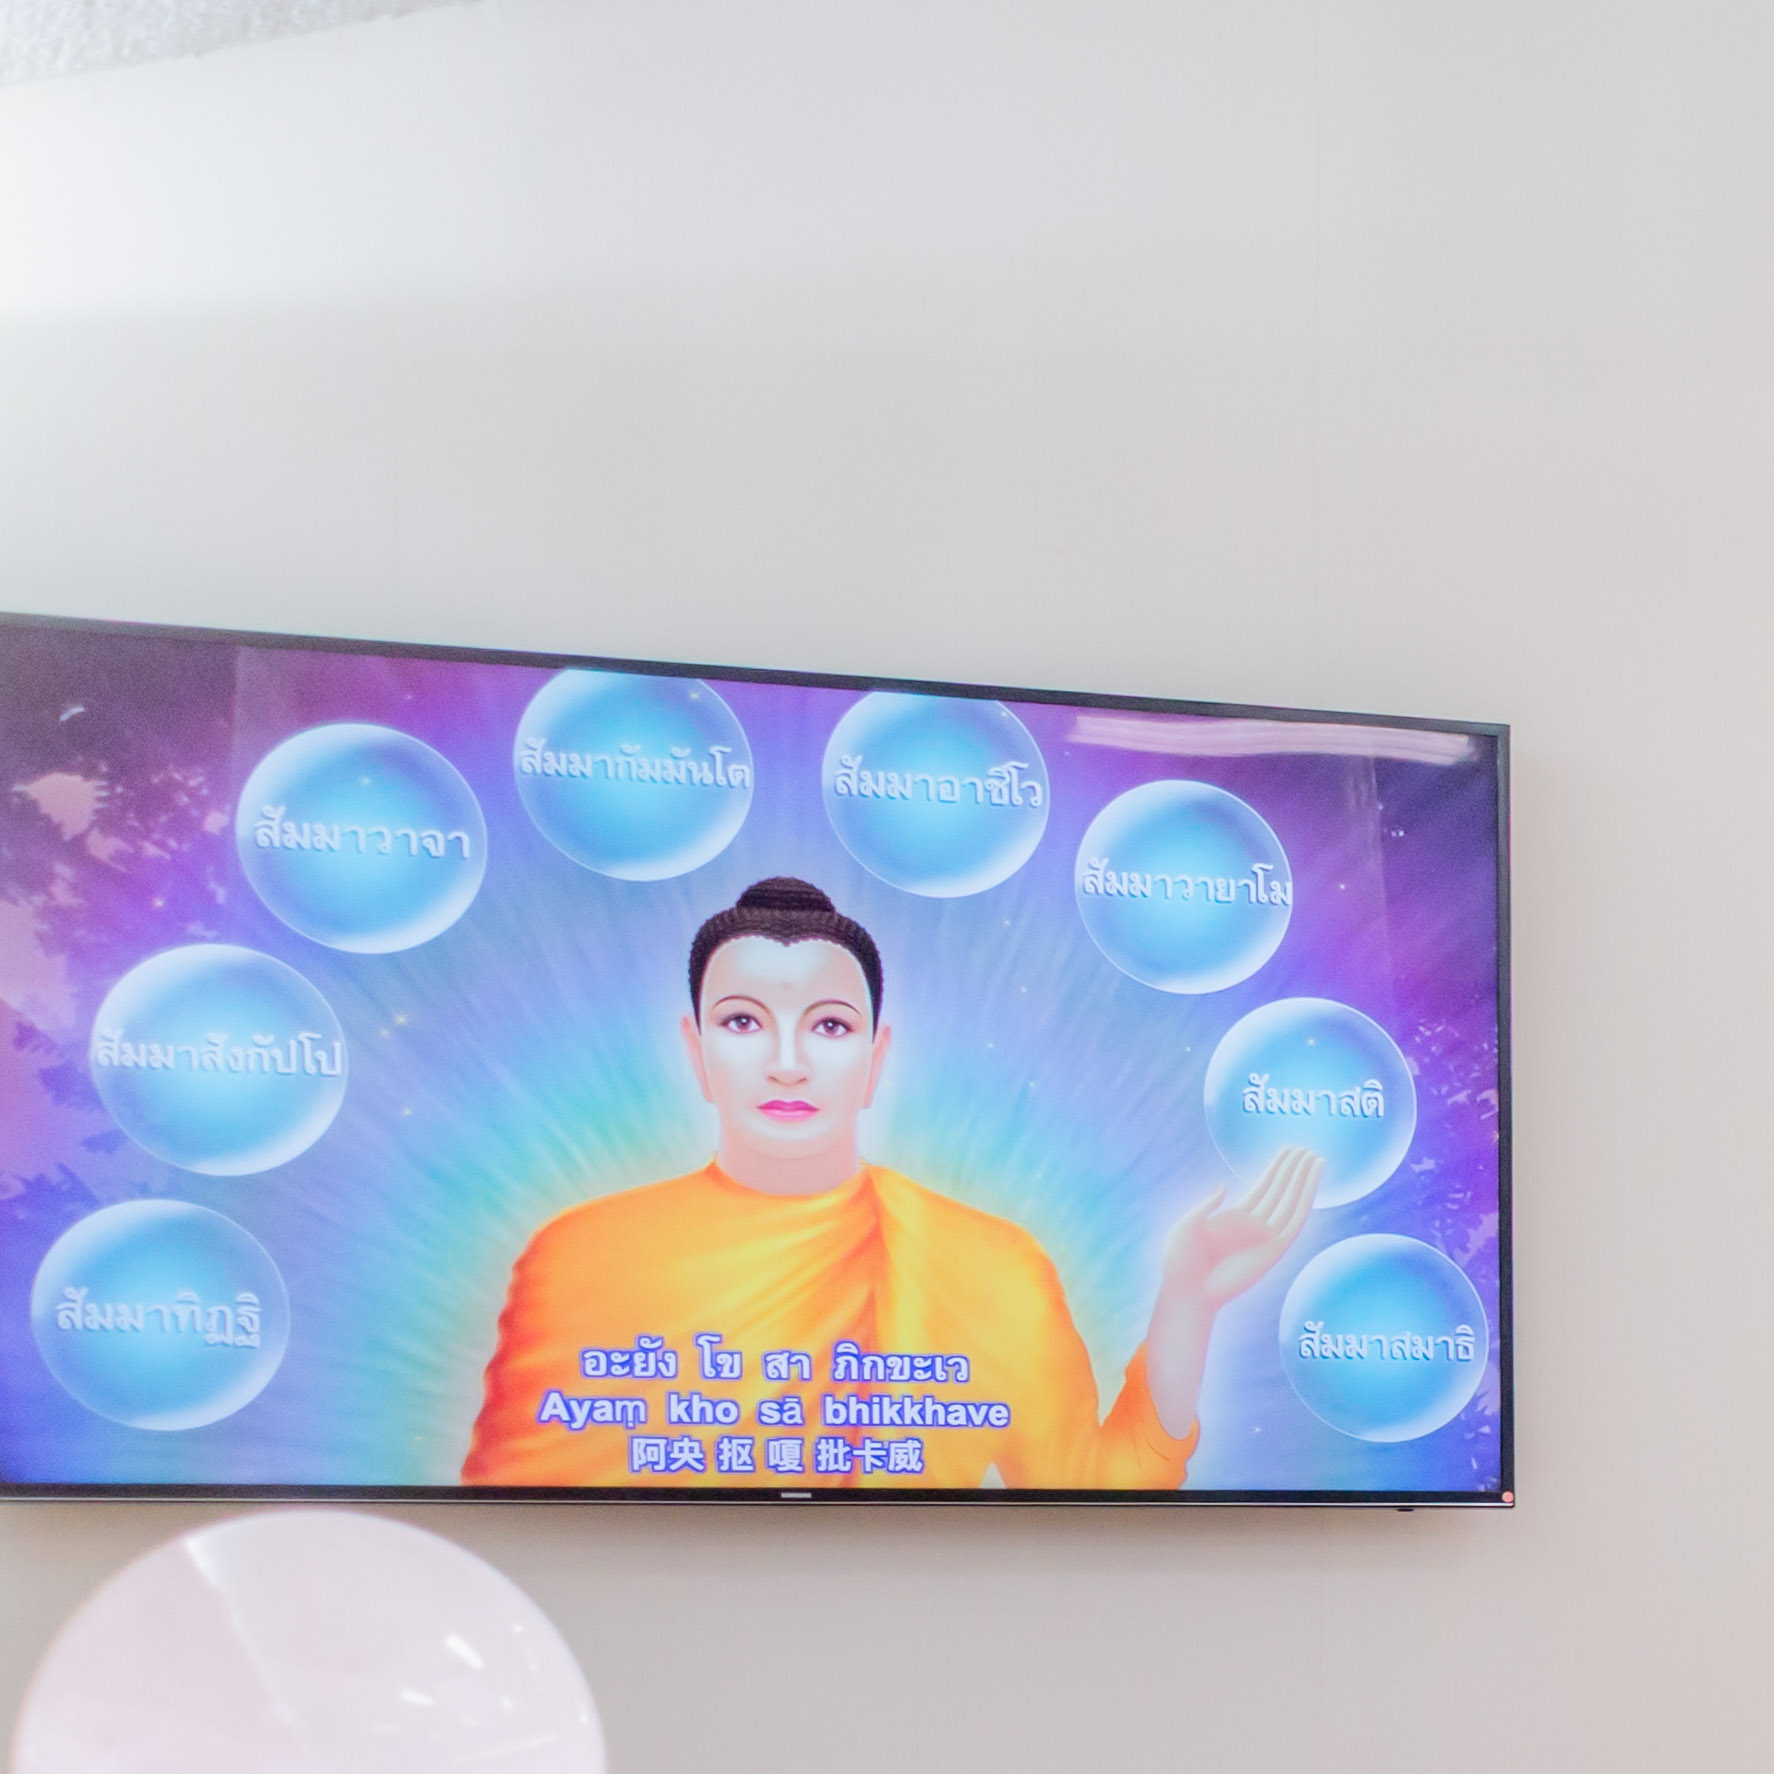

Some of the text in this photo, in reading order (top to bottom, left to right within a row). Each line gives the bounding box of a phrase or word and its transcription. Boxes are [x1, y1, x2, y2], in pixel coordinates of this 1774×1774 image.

[519, 738, 751, 787] สัมมากัมมันโต
[255, 805, 471, 859] สัมมาวาจา
[1082, 857, 1292, 906] สัมมาวายาโม
[97, 1029, 342, 1076] สัมมาสังกัปโป
[1242, 1073, 1385, 1118] สัมมาสติ
[583, 1334, 969, 1382] อะยัง โข สา ภิกขะเว
[1298, 1320, 1475, 1361] สัมมาสมาธิ
[668, 1394, 739, 1423] kho
[758, 1397, 803, 1425] sā
[824, 1396, 1009, 1426] bhikkhave
[632, 1438, 704, 1471] 阿央
[718, 1438, 754, 1472] 抠
[817, 1438, 923, 1473] 批卡威
